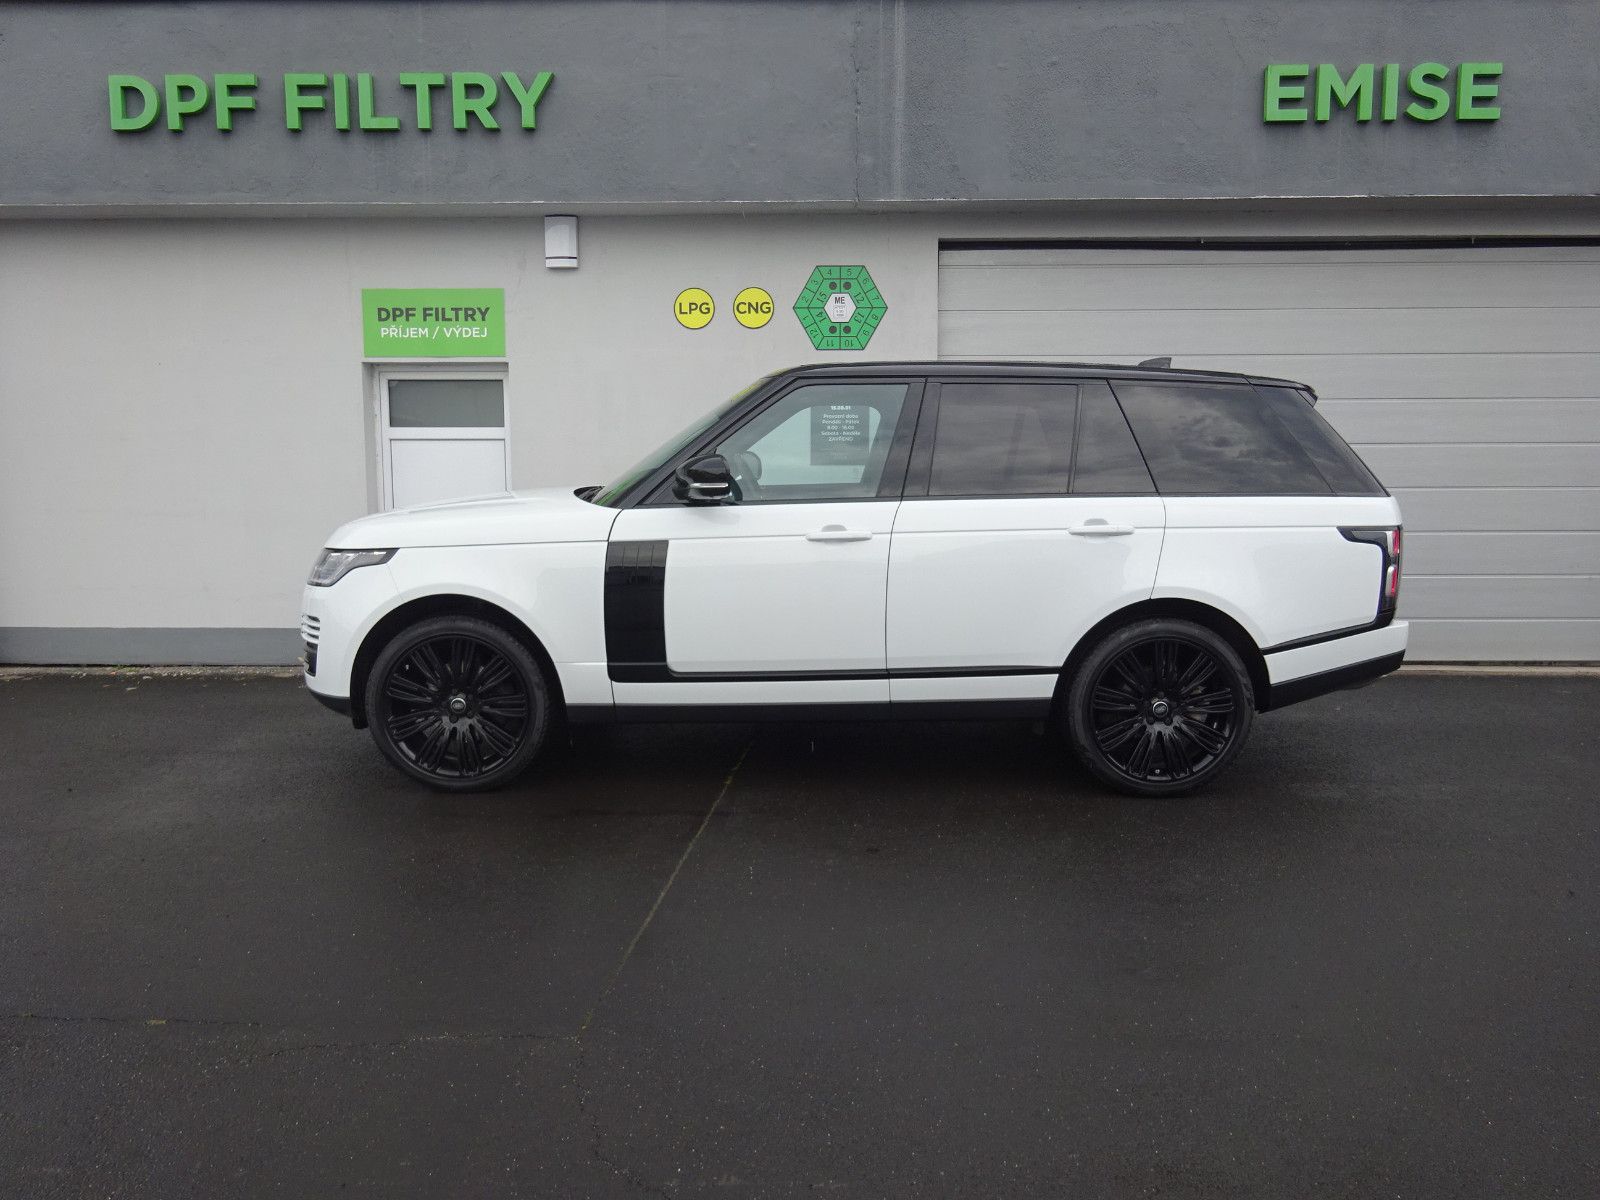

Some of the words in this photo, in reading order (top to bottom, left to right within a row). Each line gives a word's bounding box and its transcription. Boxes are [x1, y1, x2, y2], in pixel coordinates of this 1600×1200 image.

[1264, 62, 1503, 122] EMISE
[107, 72, 259, 132] DPF
[283, 71, 555, 132] FILTRY
[847, 268, 852, 276] 5
[816, 291, 827, 303] 15
[834, 296, 845, 304] ME
[853, 291, 865, 303] 12
[678, 302, 711, 315] LPG
[736, 301, 771, 315] CNG
[377, 307, 417, 322] DPF
[422, 307, 490, 322] FILTRY
[816, 311, 826, 323] 14
[854, 311, 865, 323] 13
[380, 325, 428, 338] PŘÍJEM
[432, 326, 439, 339] /
[443, 325, 487, 338] VÝDEJ
[810, 329, 818, 339] 12
[826, 339, 834, 347] 11
[845, 339, 853, 347] 10
